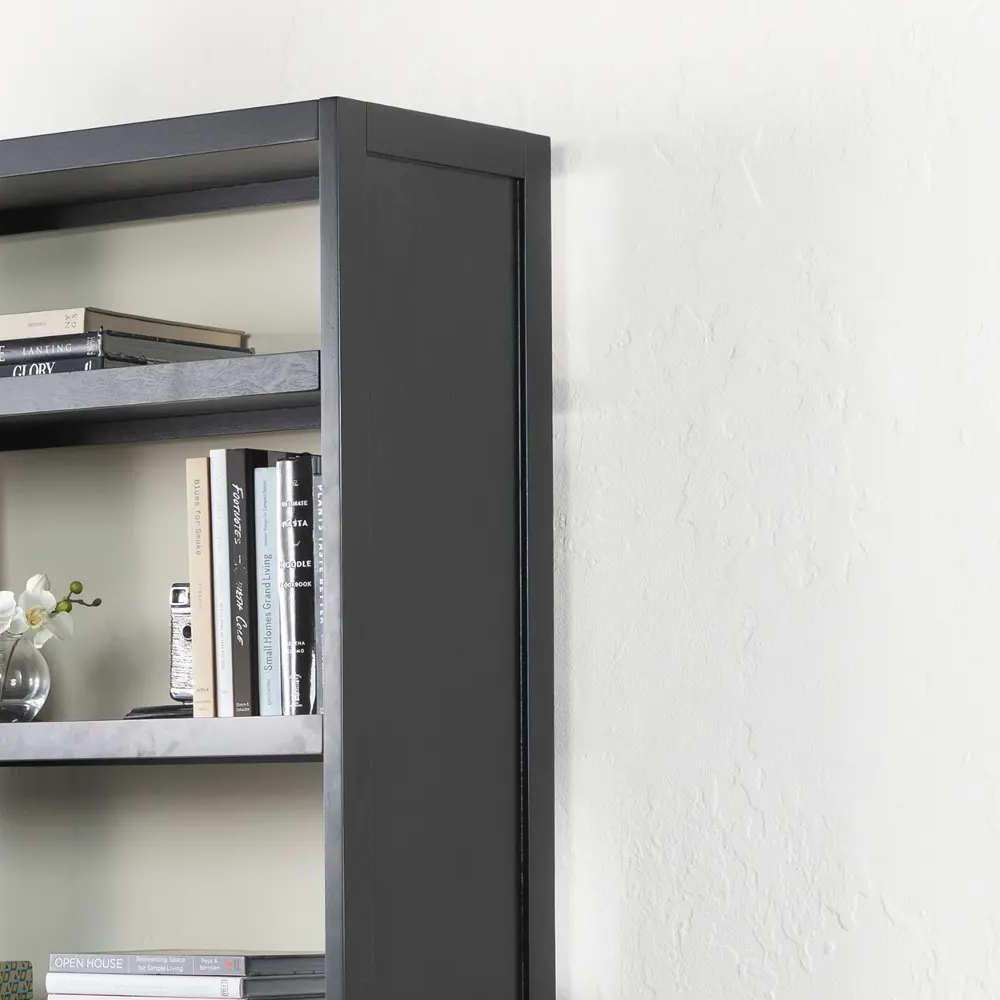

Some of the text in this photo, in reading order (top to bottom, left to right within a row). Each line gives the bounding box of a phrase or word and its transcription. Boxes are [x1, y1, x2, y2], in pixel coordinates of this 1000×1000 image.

[22, 343, 72, 356] LANTING
[282, 520, 308, 528] PASTA
[280, 560, 312, 570] NOODLE
[262, 554, 272, 670] Small Homes Grand Living
[54, 958, 122, 968] OPEN HOUSE
